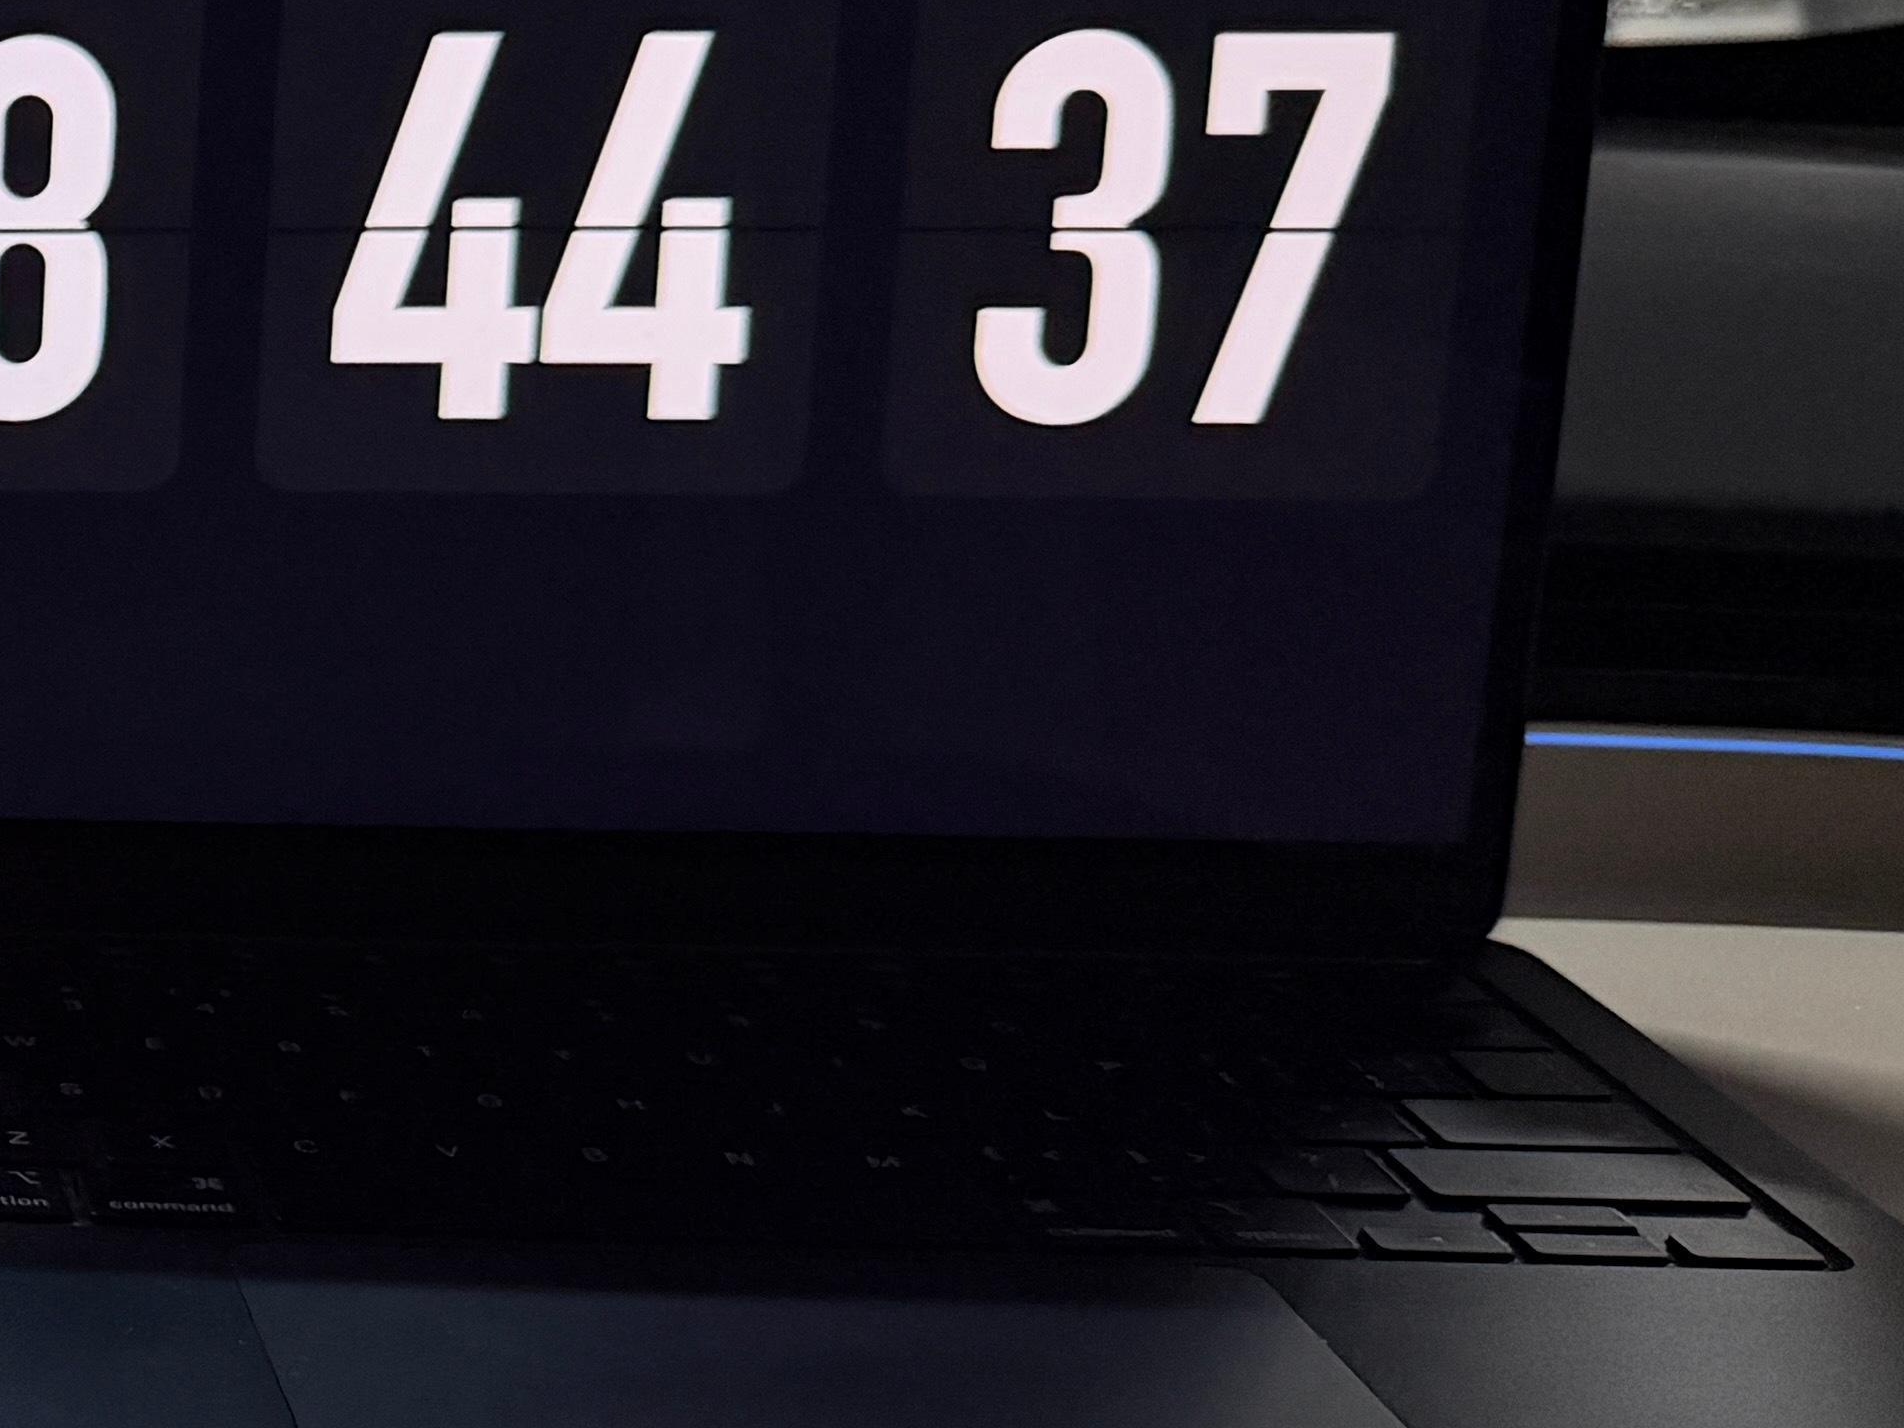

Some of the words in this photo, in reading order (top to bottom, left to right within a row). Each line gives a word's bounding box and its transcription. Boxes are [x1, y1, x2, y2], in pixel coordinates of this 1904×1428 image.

[330, 31, 752, 421] 44
[974, 29, 1397, 425] 37
[108, 1199, 235, 1214] command
